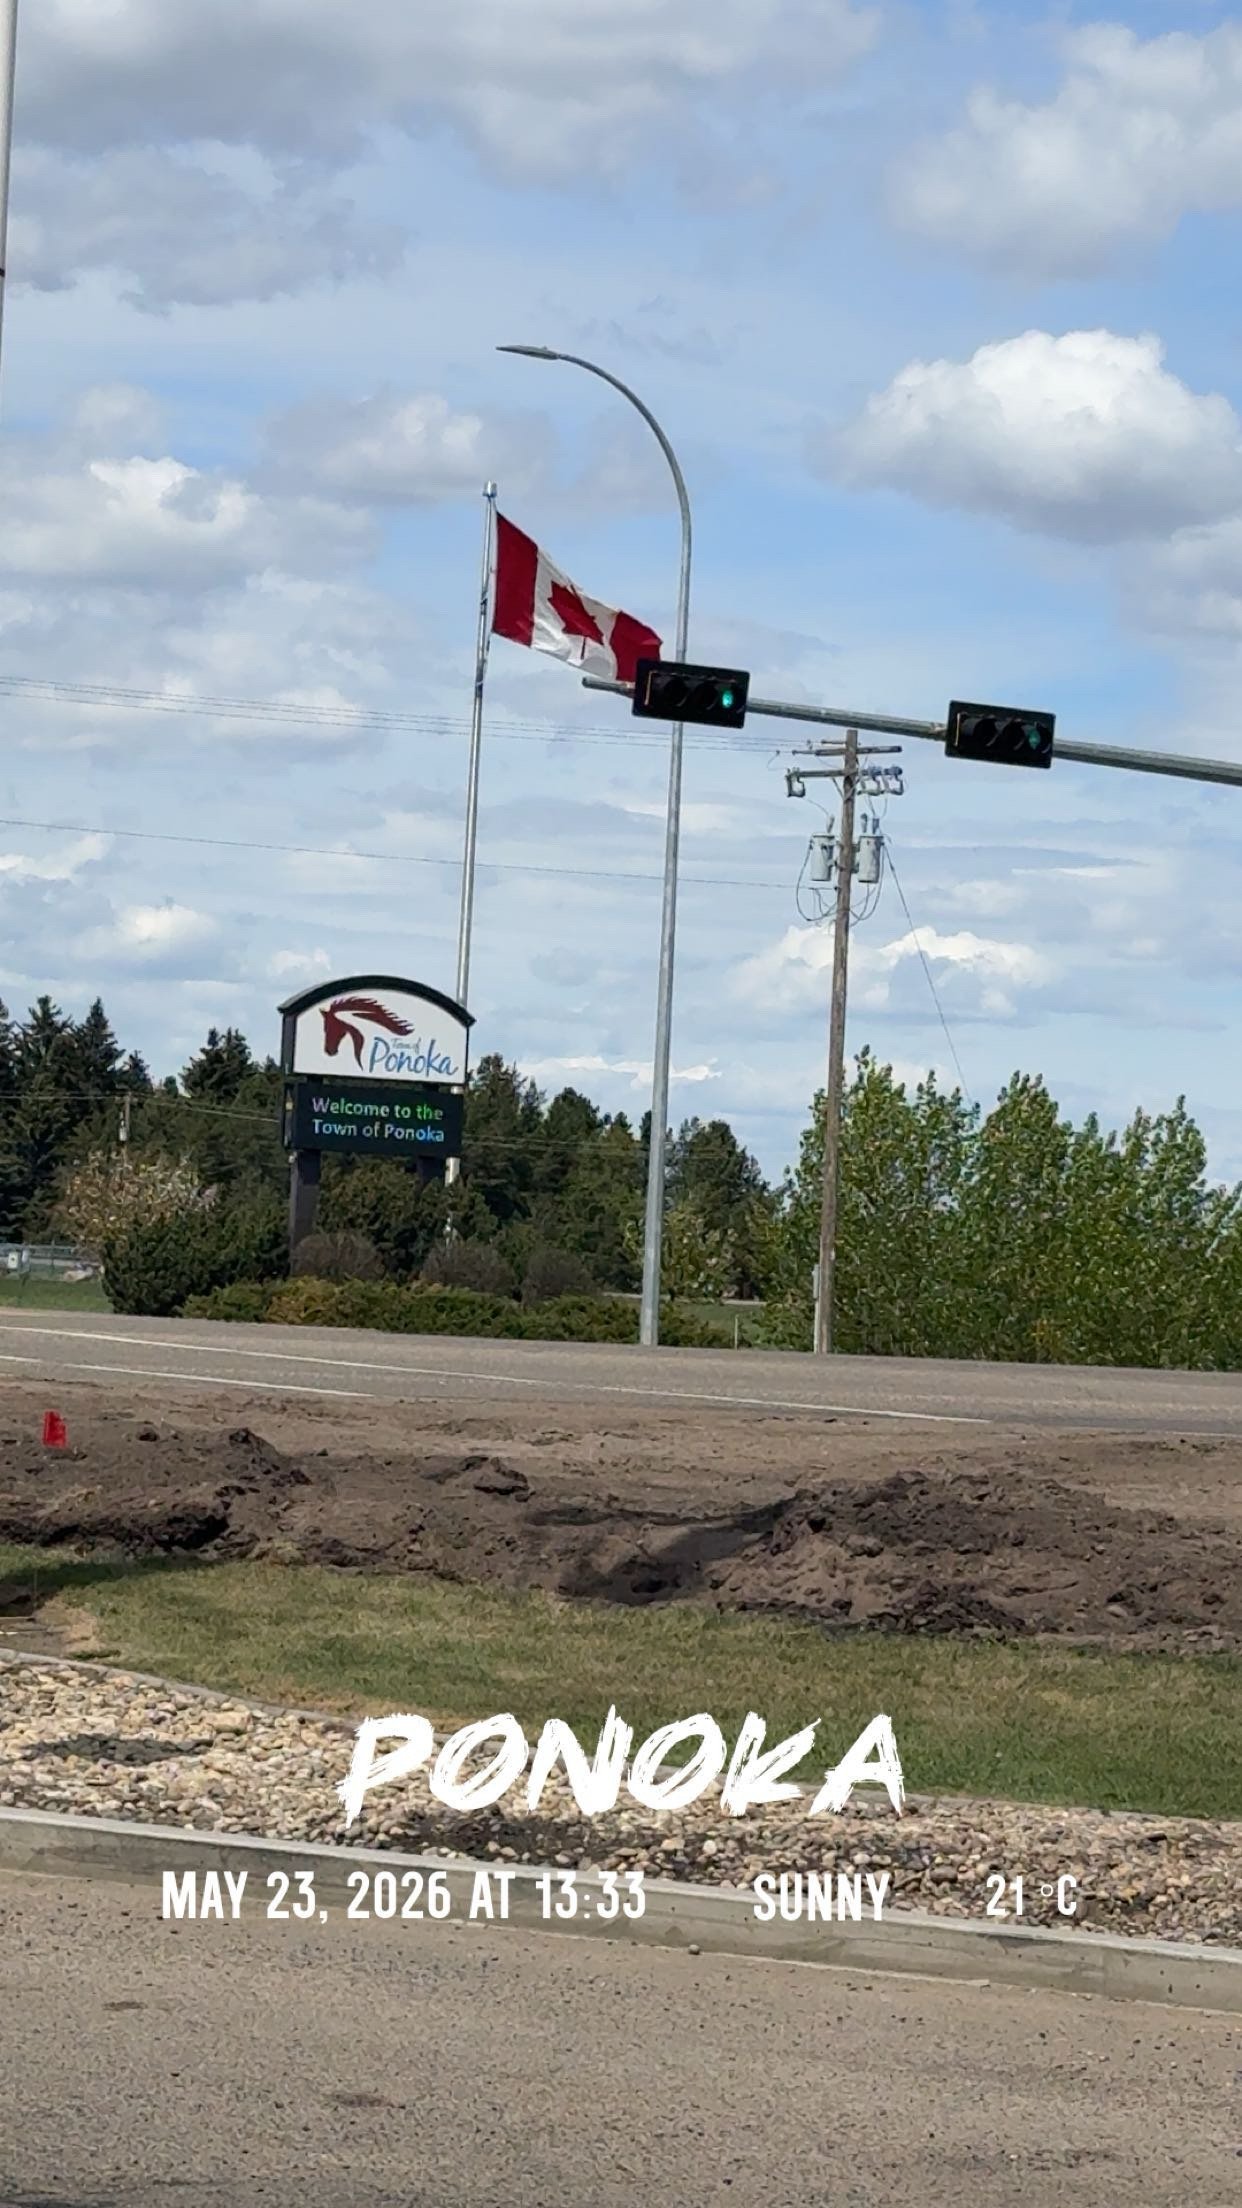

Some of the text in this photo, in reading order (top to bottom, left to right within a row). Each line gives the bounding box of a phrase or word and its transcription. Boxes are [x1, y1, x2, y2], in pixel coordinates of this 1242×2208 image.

[368, 1036, 459, 1077] Ponoka
[312, 1097, 443, 1120] Welcome to the
[312, 1119, 445, 1142] Town of Ponoka
